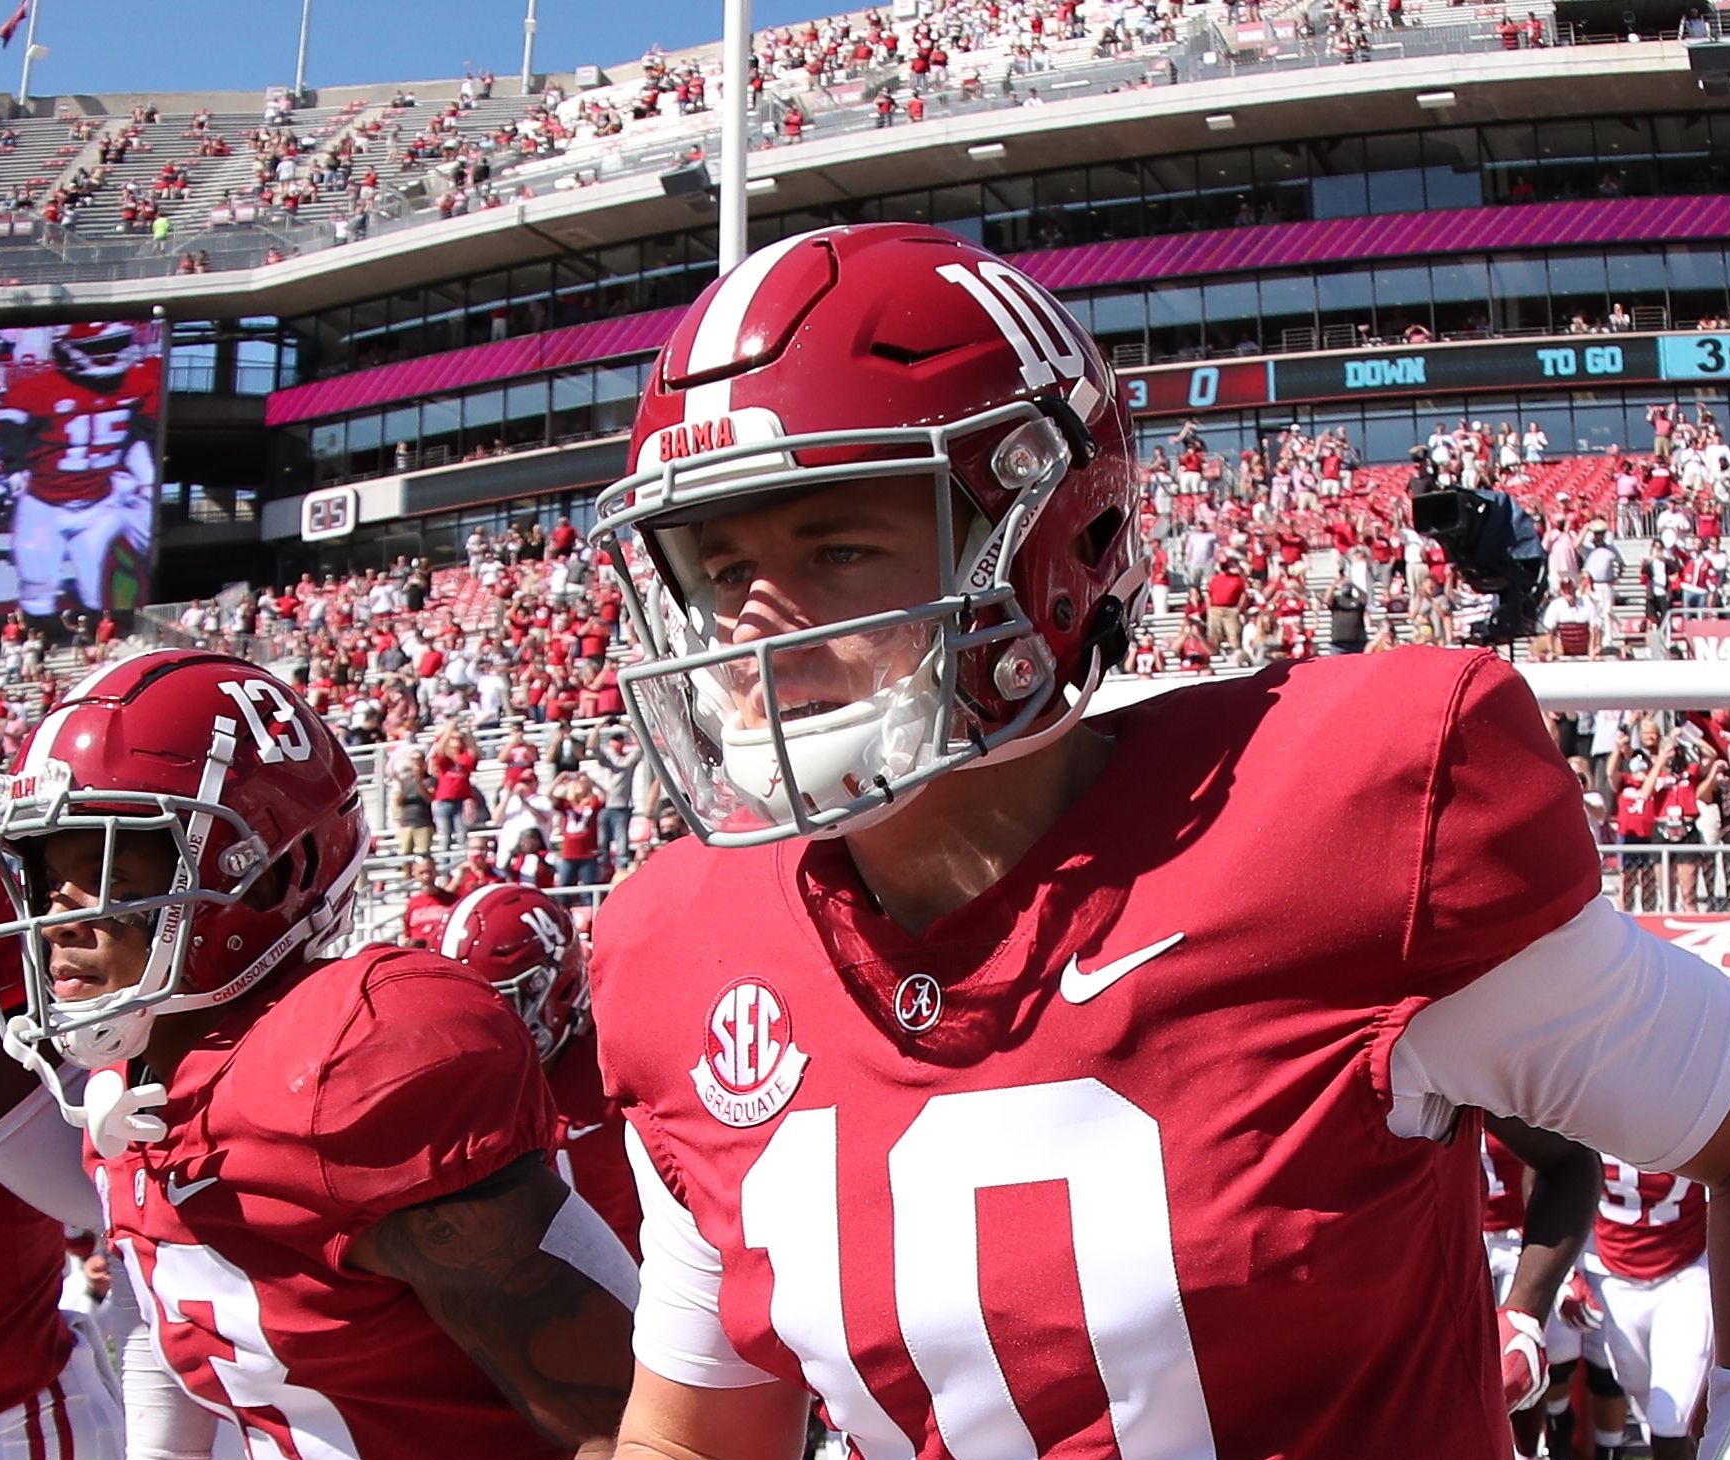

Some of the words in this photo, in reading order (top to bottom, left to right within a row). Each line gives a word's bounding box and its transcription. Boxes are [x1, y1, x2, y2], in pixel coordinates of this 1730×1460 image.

[936, 261, 1084, 388] 10
[1345, 356, 1426, 388] DOWN
[1537, 348, 1576, 377] TO
[1585, 346, 1624, 374] GO
[1127, 380, 1147, 408] 3
[1189, 367, 1219, 407] 0
[57, 408, 131, 472] 15
[659, 417, 734, 462] BAMA
[311, 498, 346, 531] 25
[218, 680, 314, 764] 13
[520, 906, 567, 960] 14
[212, 959, 269, 1003] CRIMSON
[270, 936, 295, 962] TIDE
[711, 983, 782, 1087] SEC
[704, 1078, 790, 1123] GRADUATE
